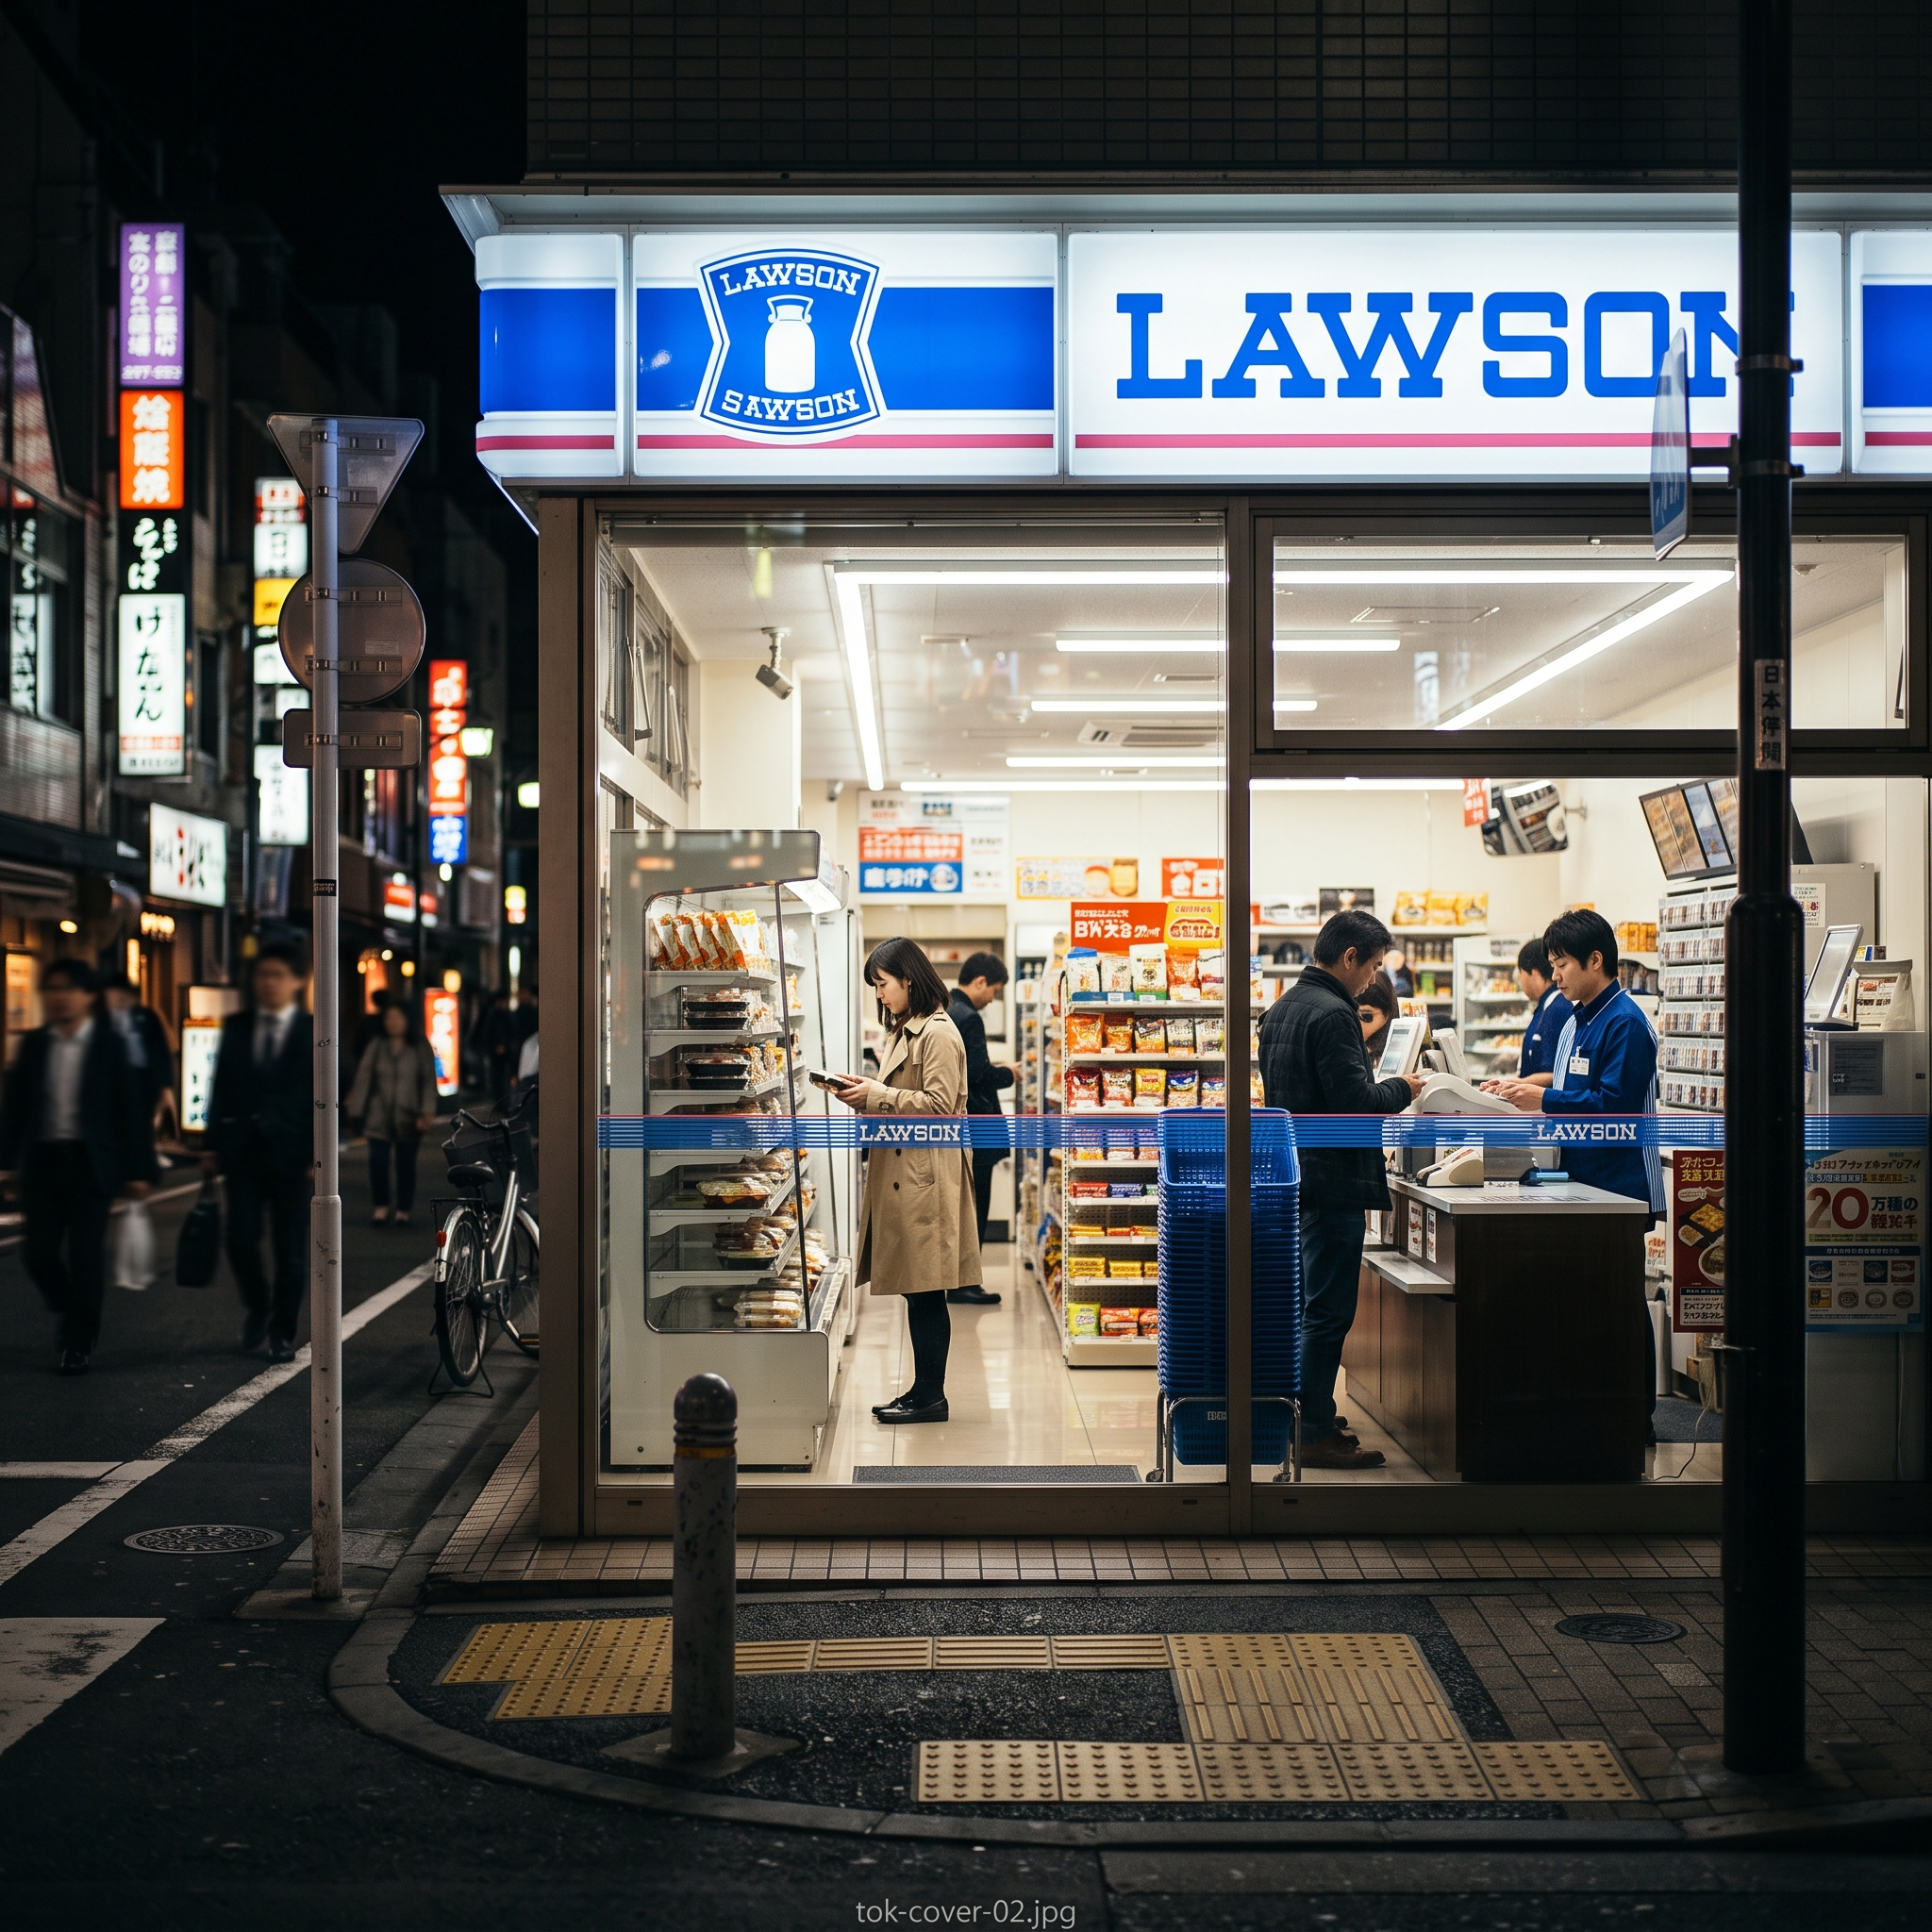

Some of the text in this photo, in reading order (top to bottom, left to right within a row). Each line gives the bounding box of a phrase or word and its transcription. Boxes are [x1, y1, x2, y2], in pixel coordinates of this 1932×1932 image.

[719, 262, 860, 297] LAWSON
[721, 389, 860, 422] SAWSON
[859, 1124, 961, 1142] LAWSON
[1537, 1124, 1637, 1141] LAWSON
[1807, 1187, 1869, 1229] 20
